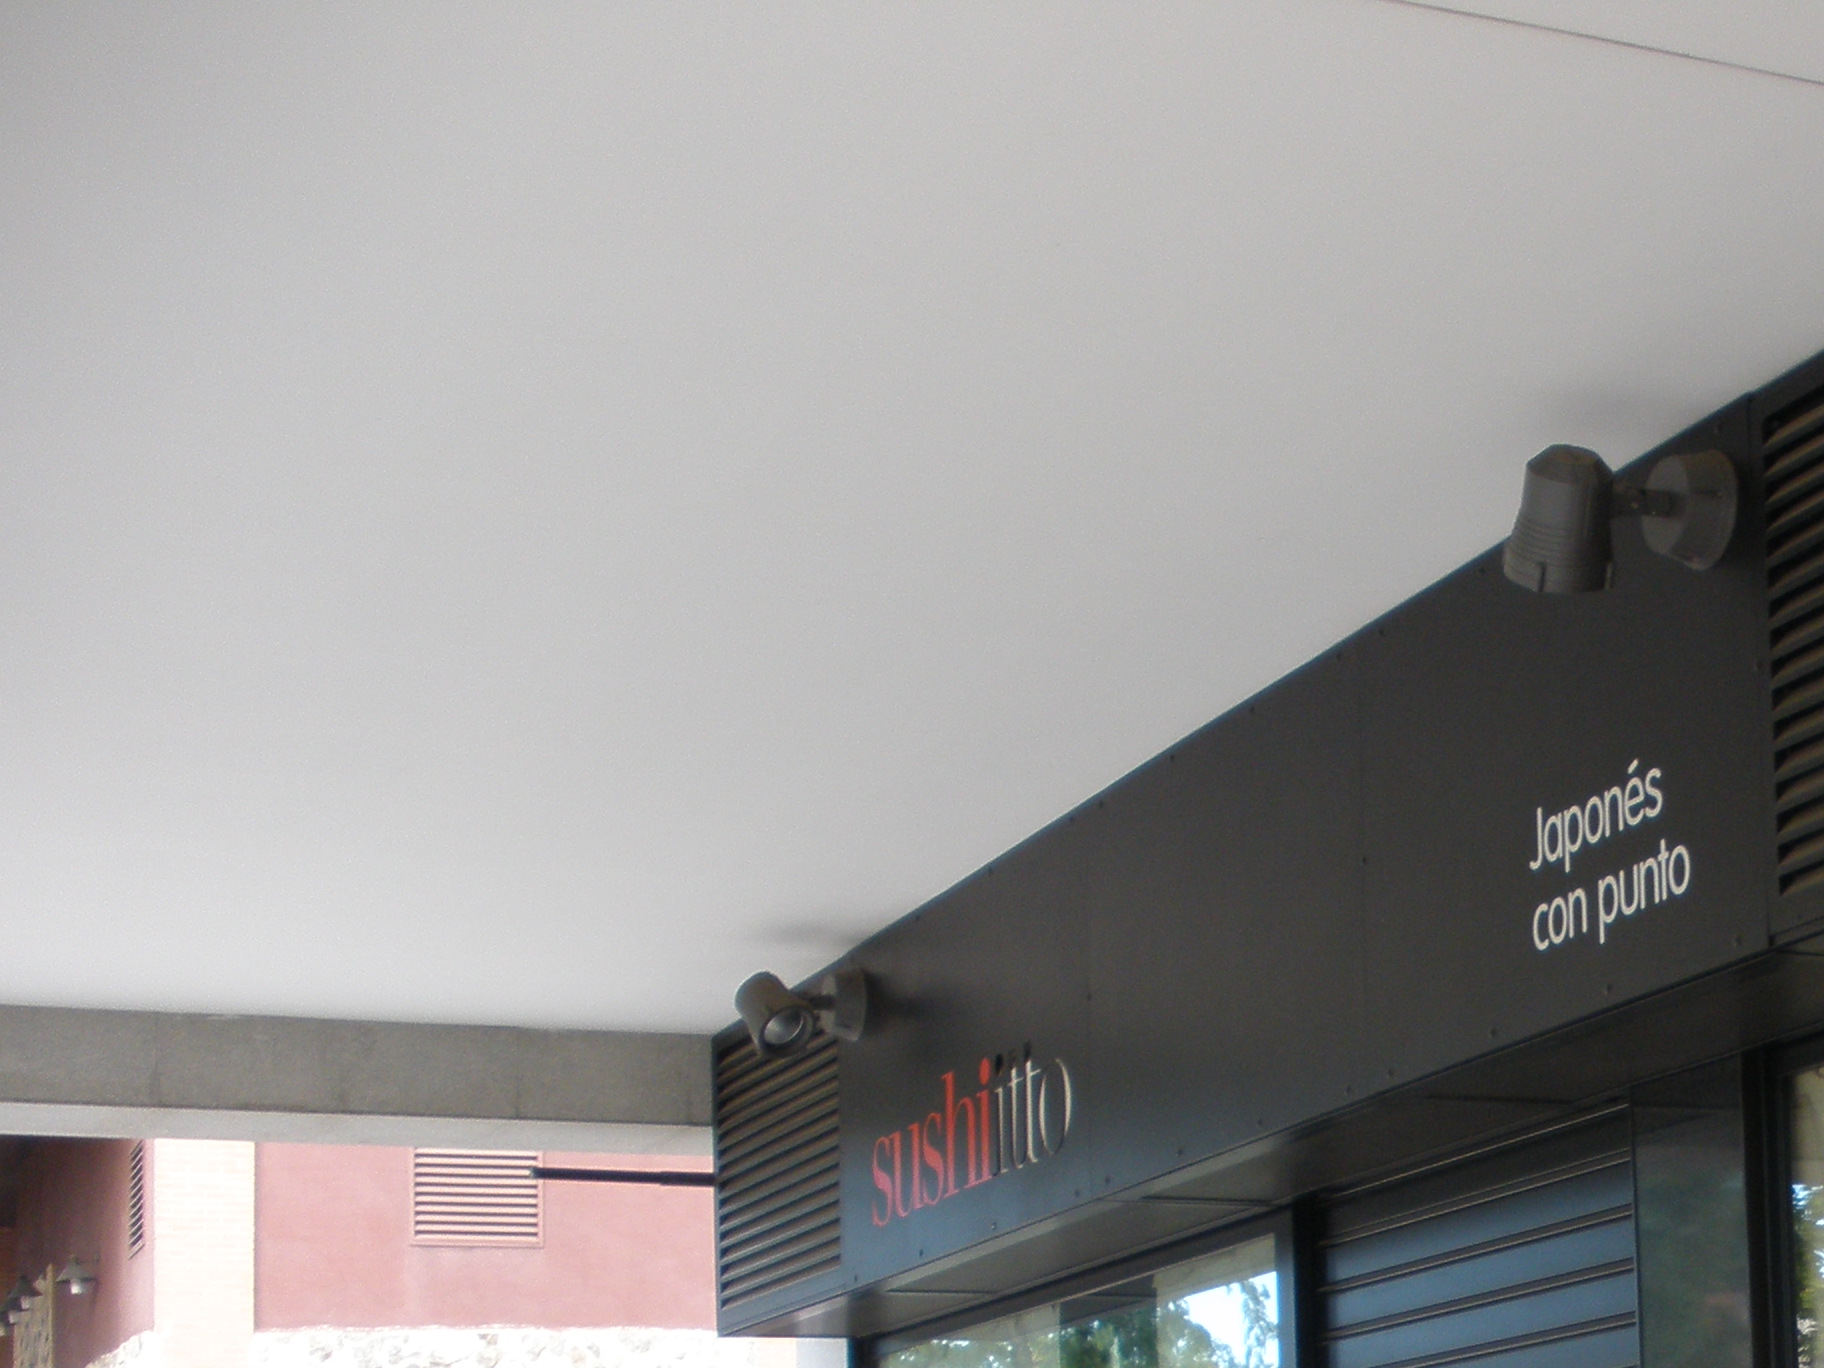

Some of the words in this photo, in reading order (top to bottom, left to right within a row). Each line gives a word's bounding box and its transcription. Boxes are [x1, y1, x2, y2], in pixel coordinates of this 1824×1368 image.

[1529, 758, 1663, 873] Japonés
[1533, 887, 1588, 951] con
[1598, 838, 1690, 944] punto
